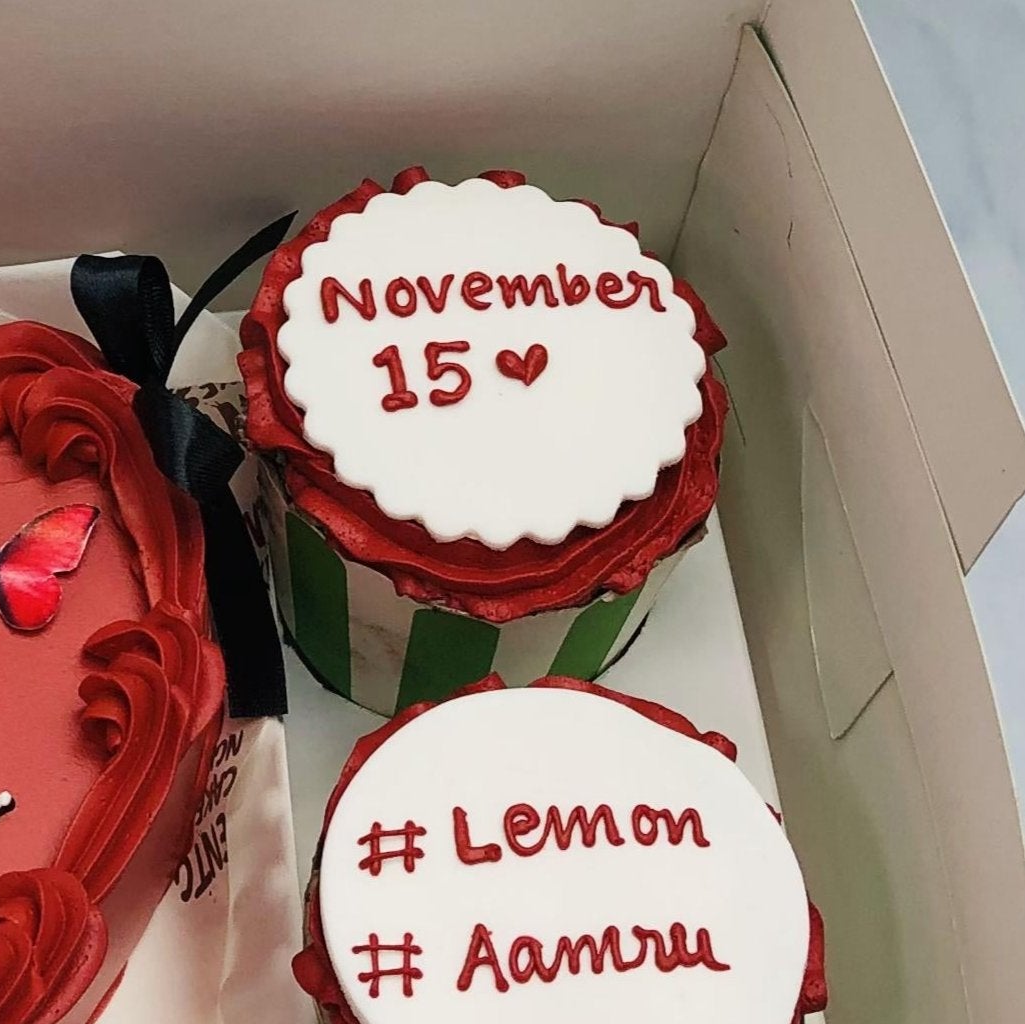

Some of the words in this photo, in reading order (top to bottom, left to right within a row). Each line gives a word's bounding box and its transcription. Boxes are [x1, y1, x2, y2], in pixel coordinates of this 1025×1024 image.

[320, 263, 667, 324] November
[373, 340, 472, 412] 15
[452, 803, 711, 865] Lemon
